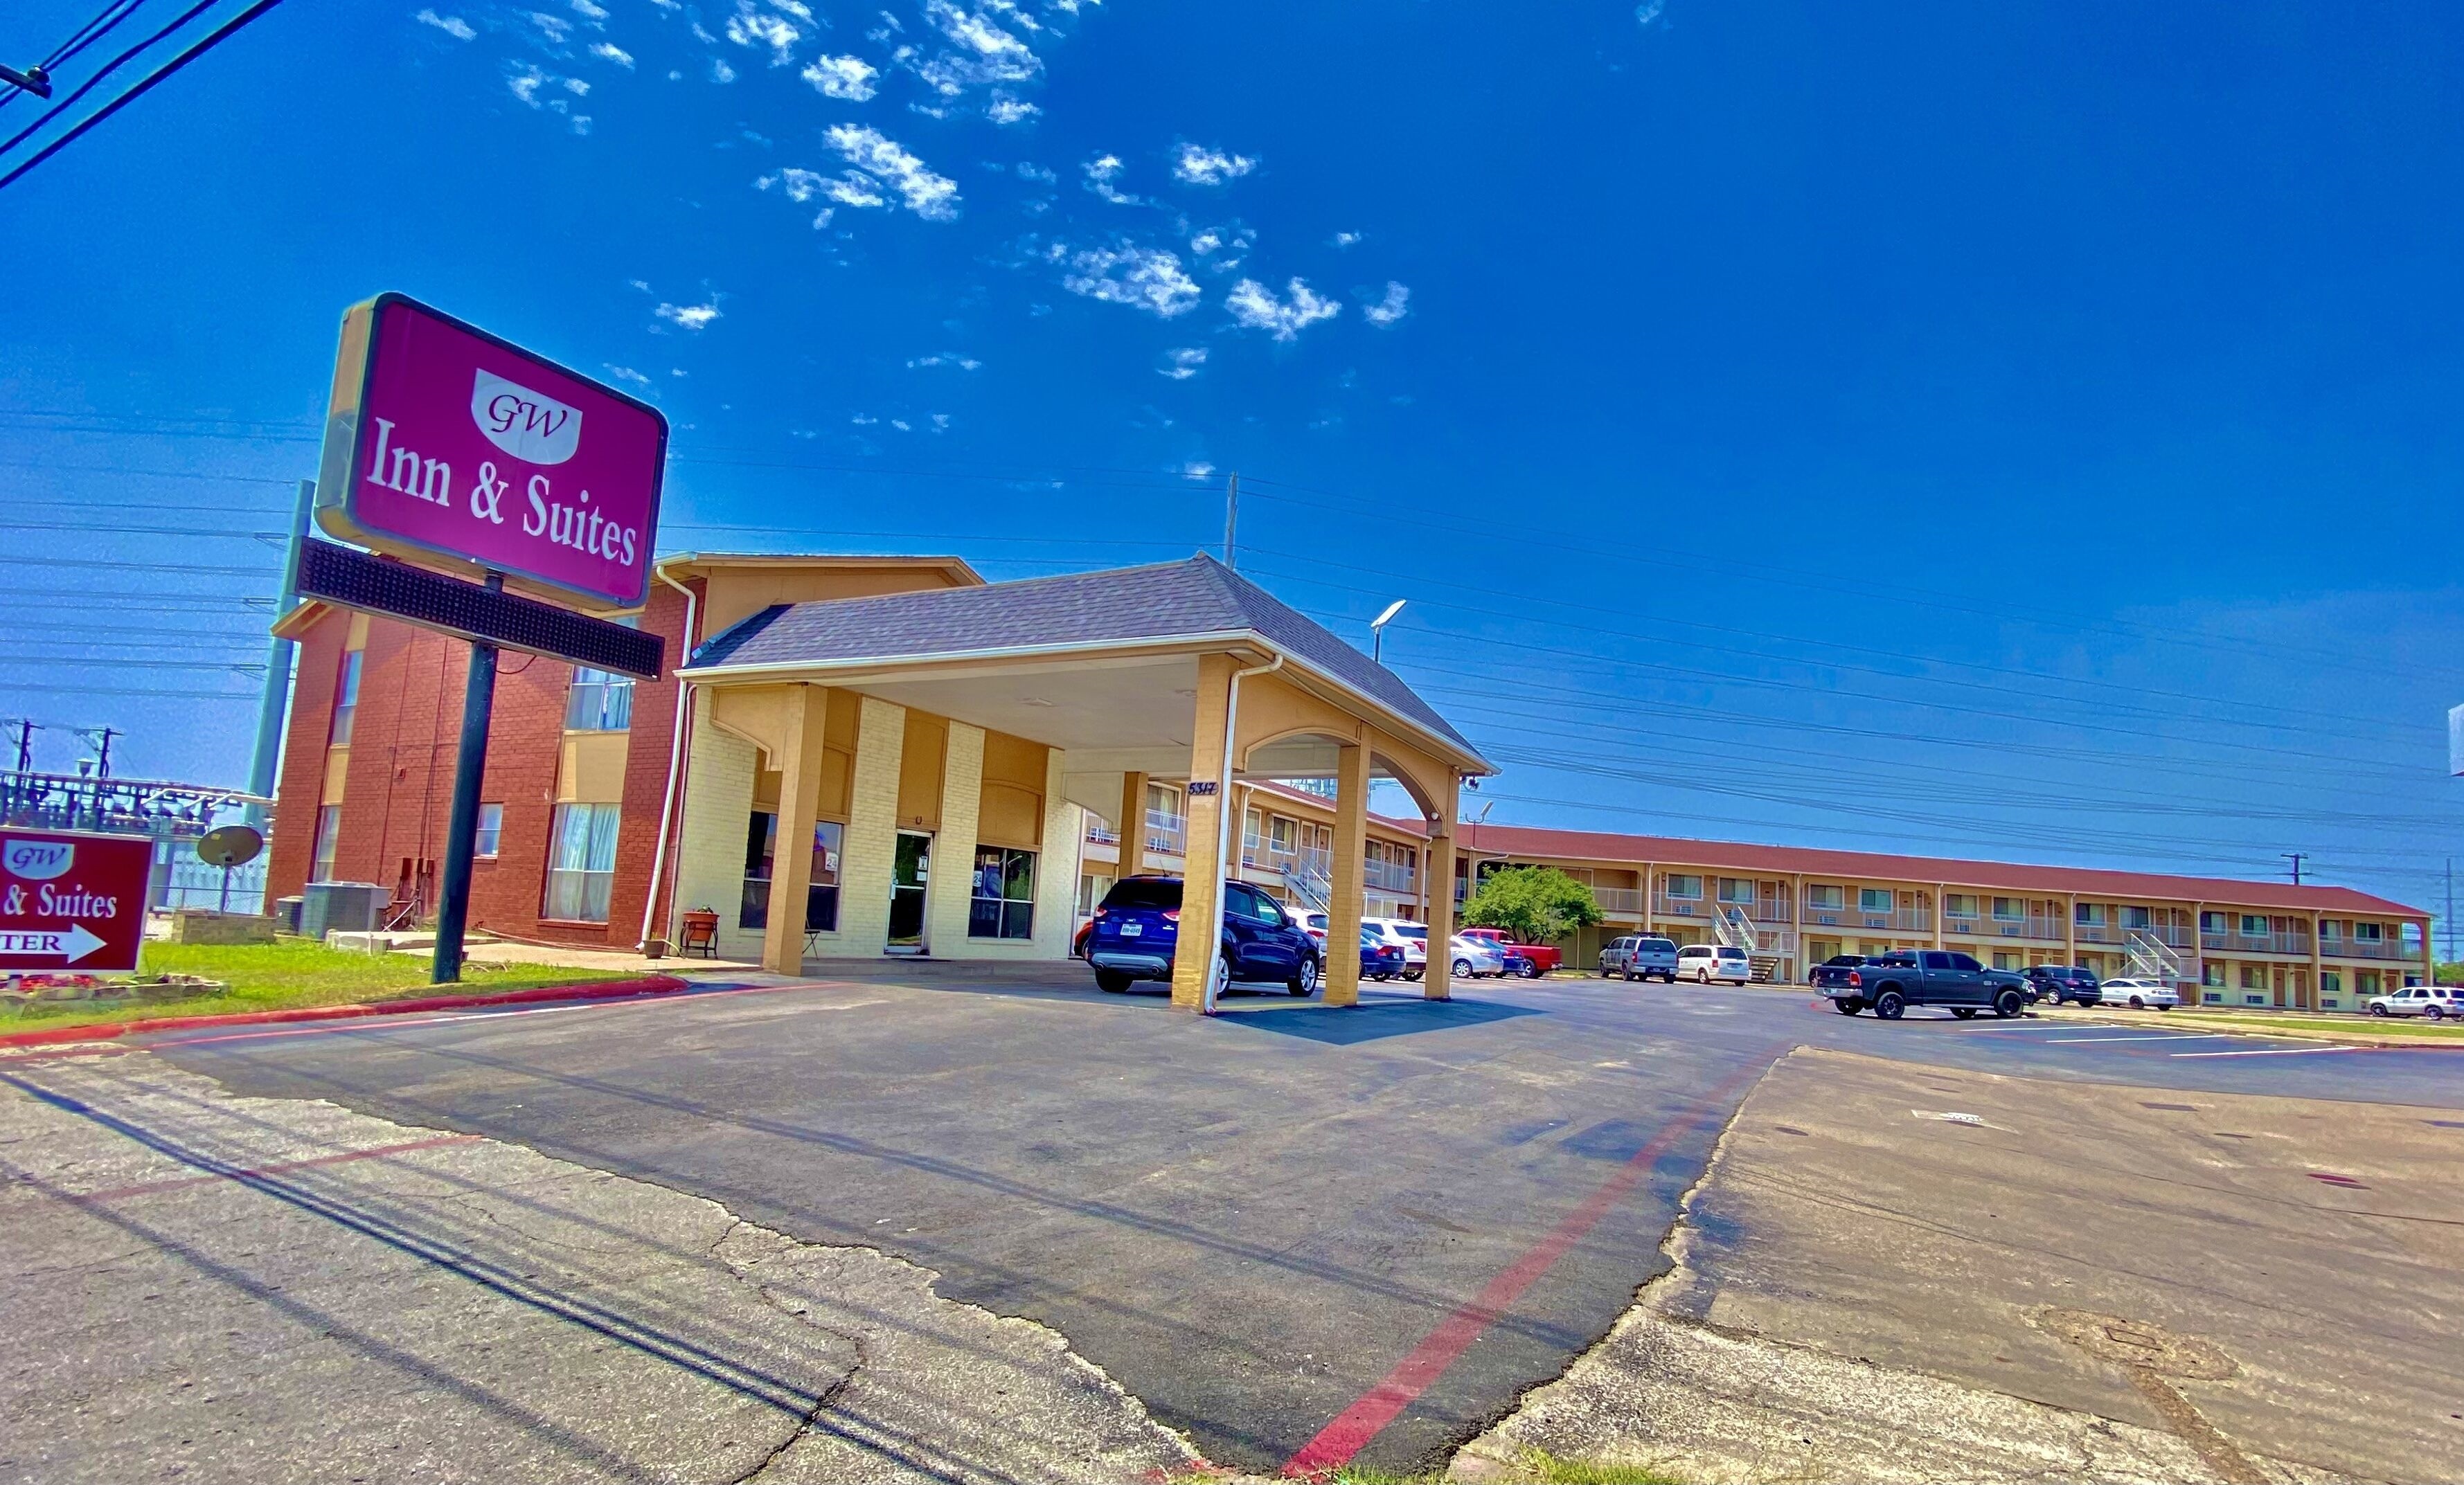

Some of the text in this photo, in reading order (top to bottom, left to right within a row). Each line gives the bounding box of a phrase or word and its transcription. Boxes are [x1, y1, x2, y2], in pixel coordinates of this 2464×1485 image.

[488, 394, 568, 438] GW
[367, 417, 637, 567] Inn & Suites
[12, 847, 67, 870] GW
[3, 883, 118, 919] & Suites
